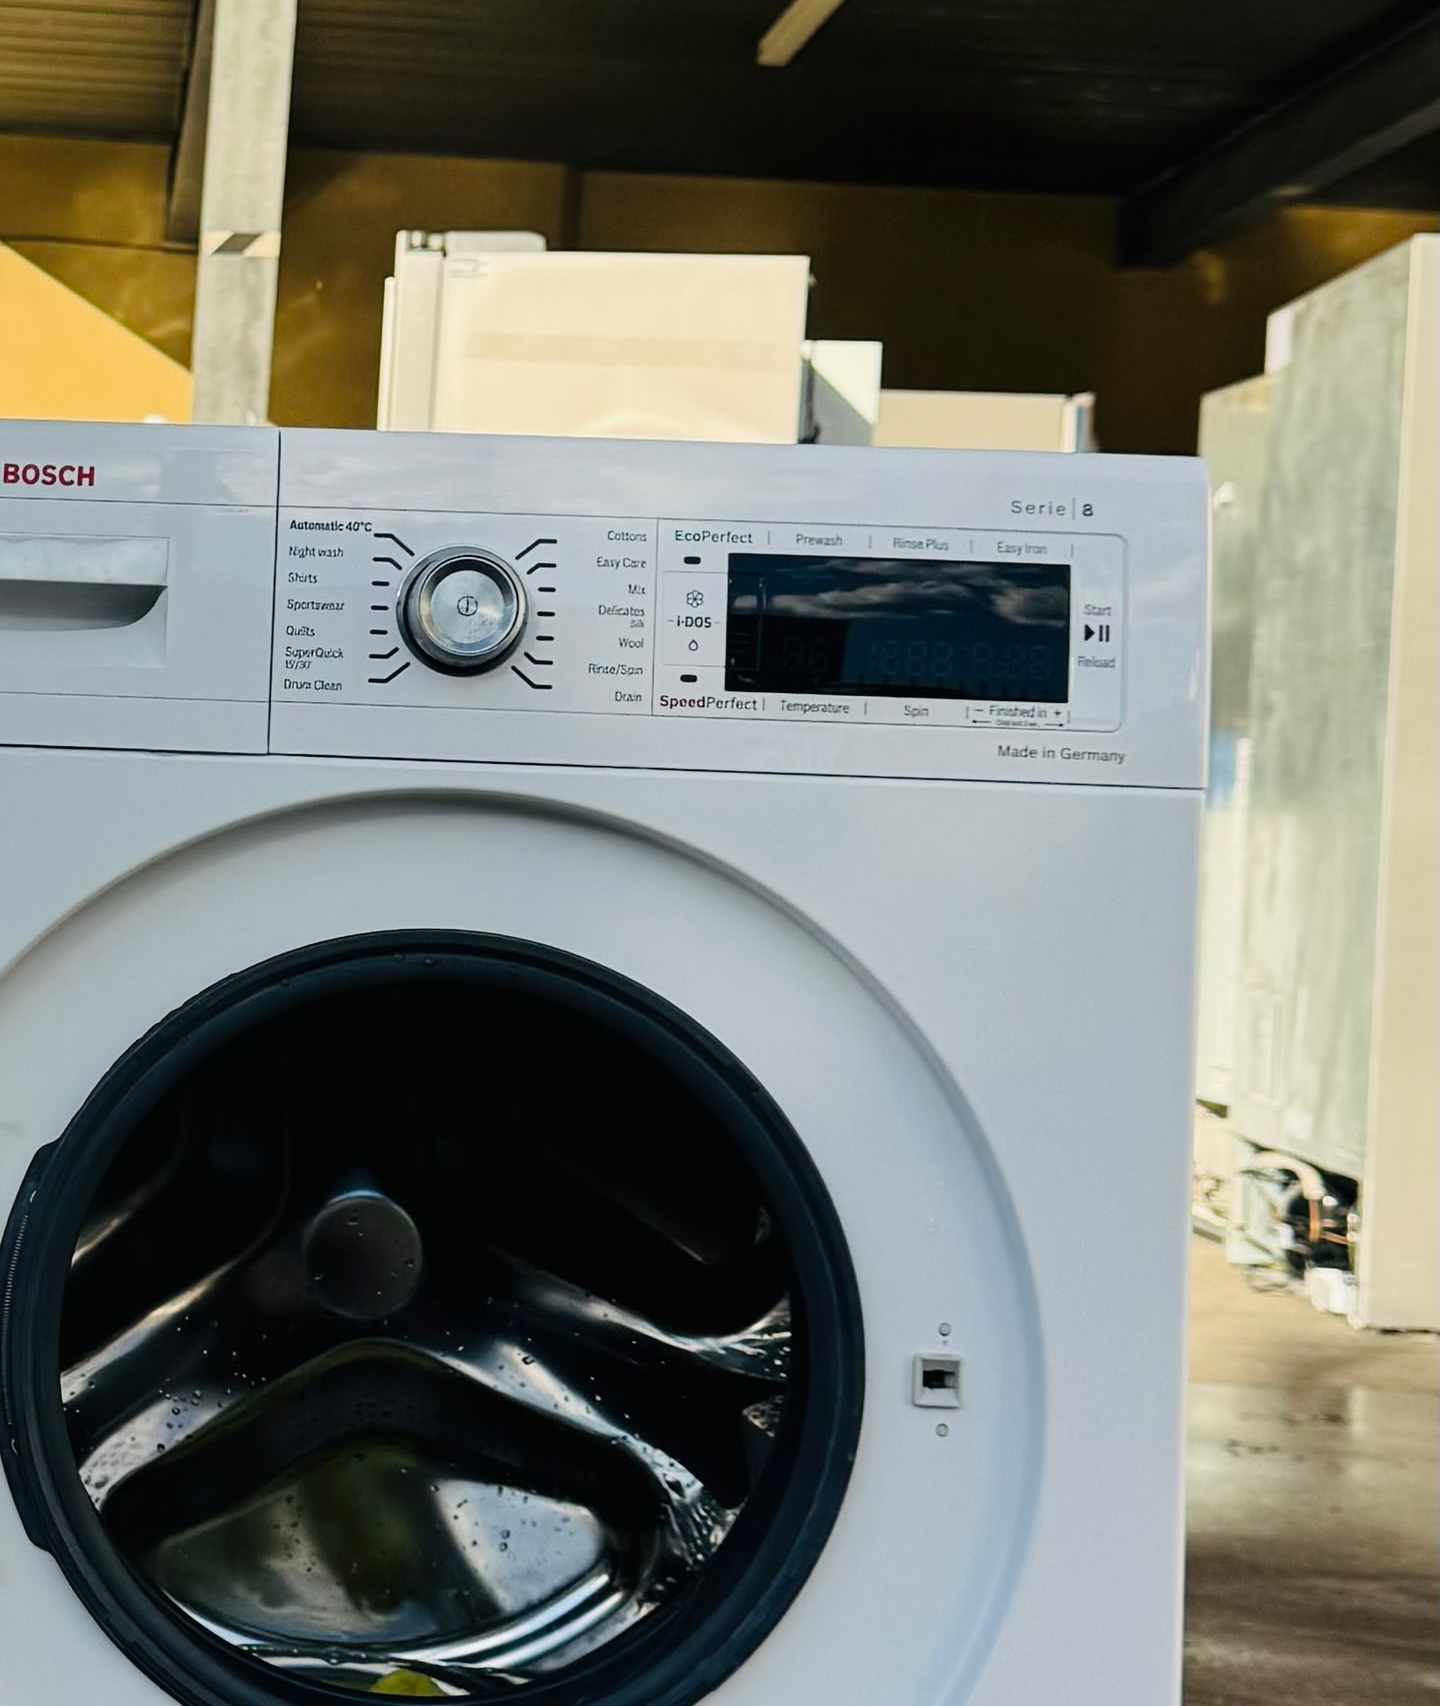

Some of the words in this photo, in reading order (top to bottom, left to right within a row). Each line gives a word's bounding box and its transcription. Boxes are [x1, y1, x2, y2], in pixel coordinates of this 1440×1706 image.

[2, 463, 96, 487] BOSCH
[1011, 500, 1066, 516] Serie
[1082, 503, 1094, 517] 8
[290, 520, 344, 531] Automatic
[675, 530, 753, 544] EcoPerfect
[796, 533, 843, 546] Prewash
[997, 541, 1022, 555] Easy
[1025, 543, 1047, 555] Iron
[597, 557, 620, 569] Easy
[1084, 604, 1112, 617] Start
[619, 637, 644, 648] Wool
[314, 680, 342, 691] Clean
[660, 695, 758, 710] SpeedPerfect
[781, 700, 850, 714] Temperature
[904, 705, 929, 718] Spin
[998, 745, 1038, 758] Made
[1043, 746, 1055, 759] in
[1060, 747, 1126, 764] Germany
